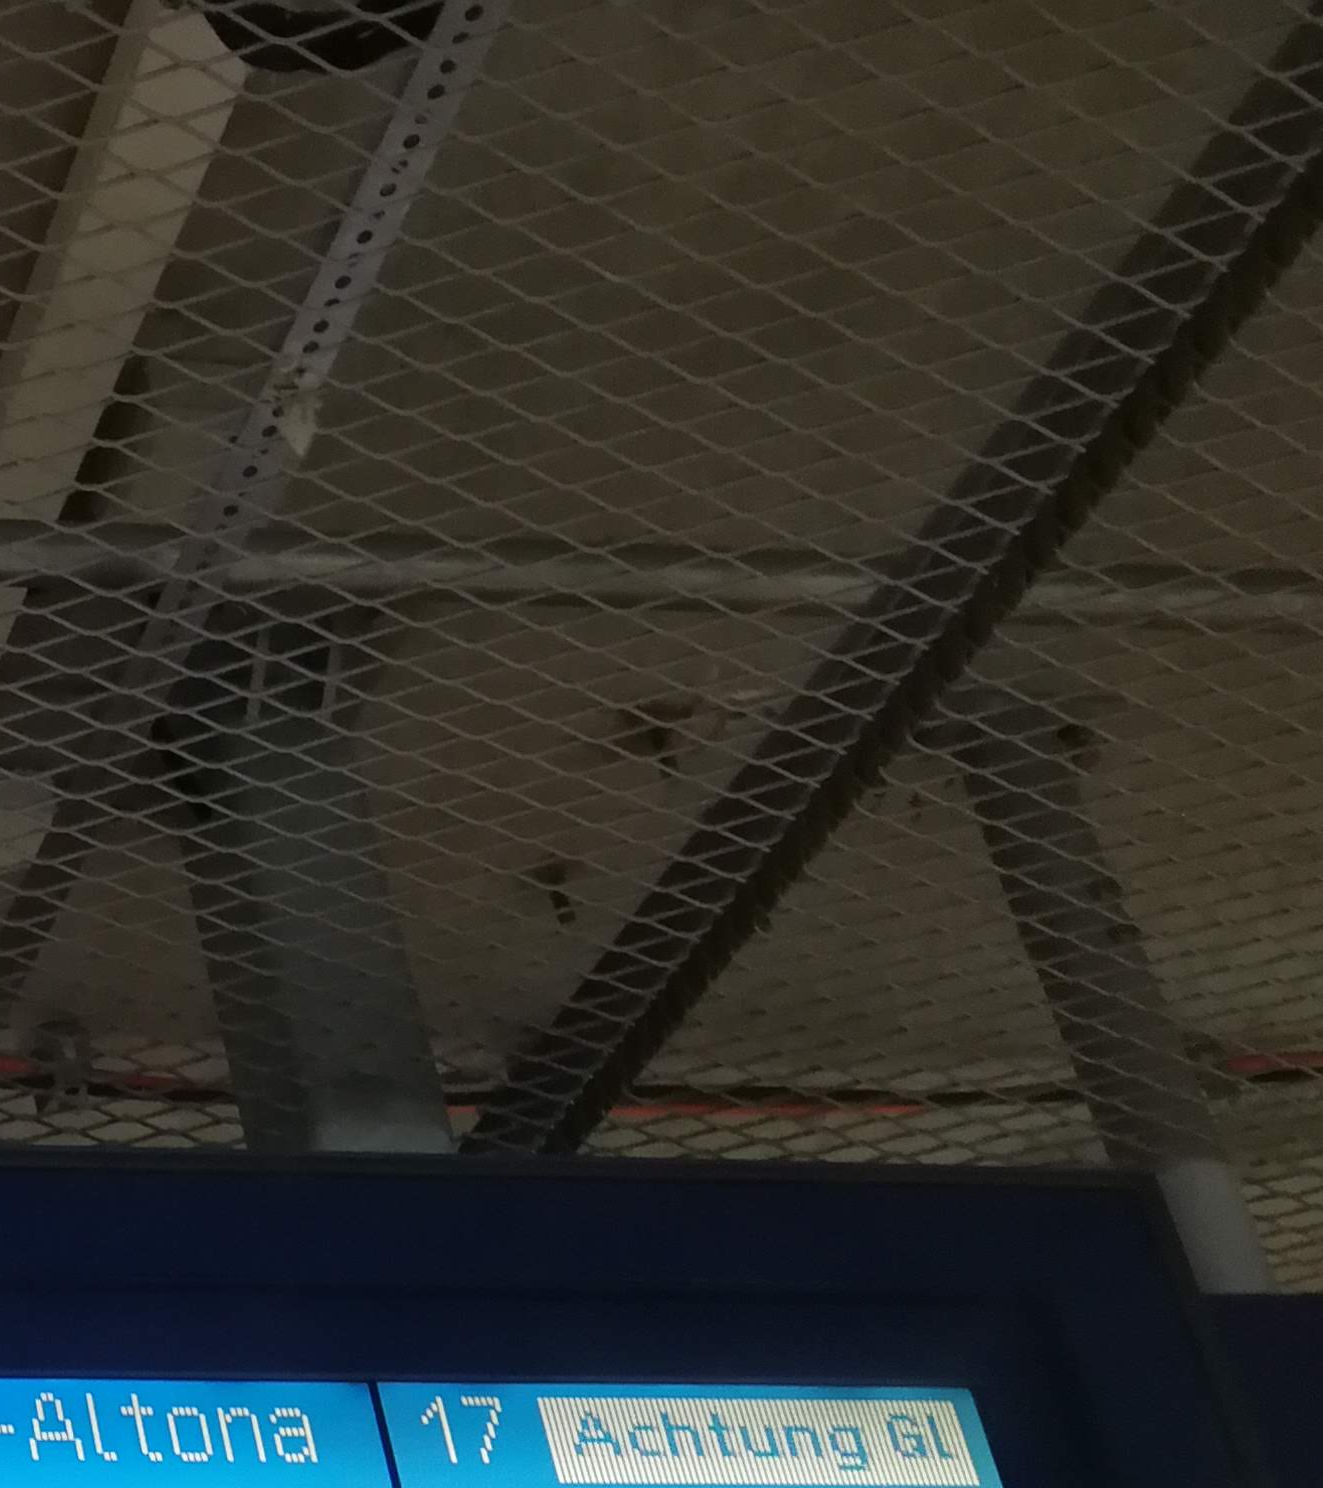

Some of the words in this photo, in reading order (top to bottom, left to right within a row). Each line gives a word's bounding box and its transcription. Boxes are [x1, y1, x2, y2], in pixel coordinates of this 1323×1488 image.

[422, 1397, 501, 1463] 17
[573, 1410, 867, 1471] Achtung
[888, 1414, 954, 1462] Gl
